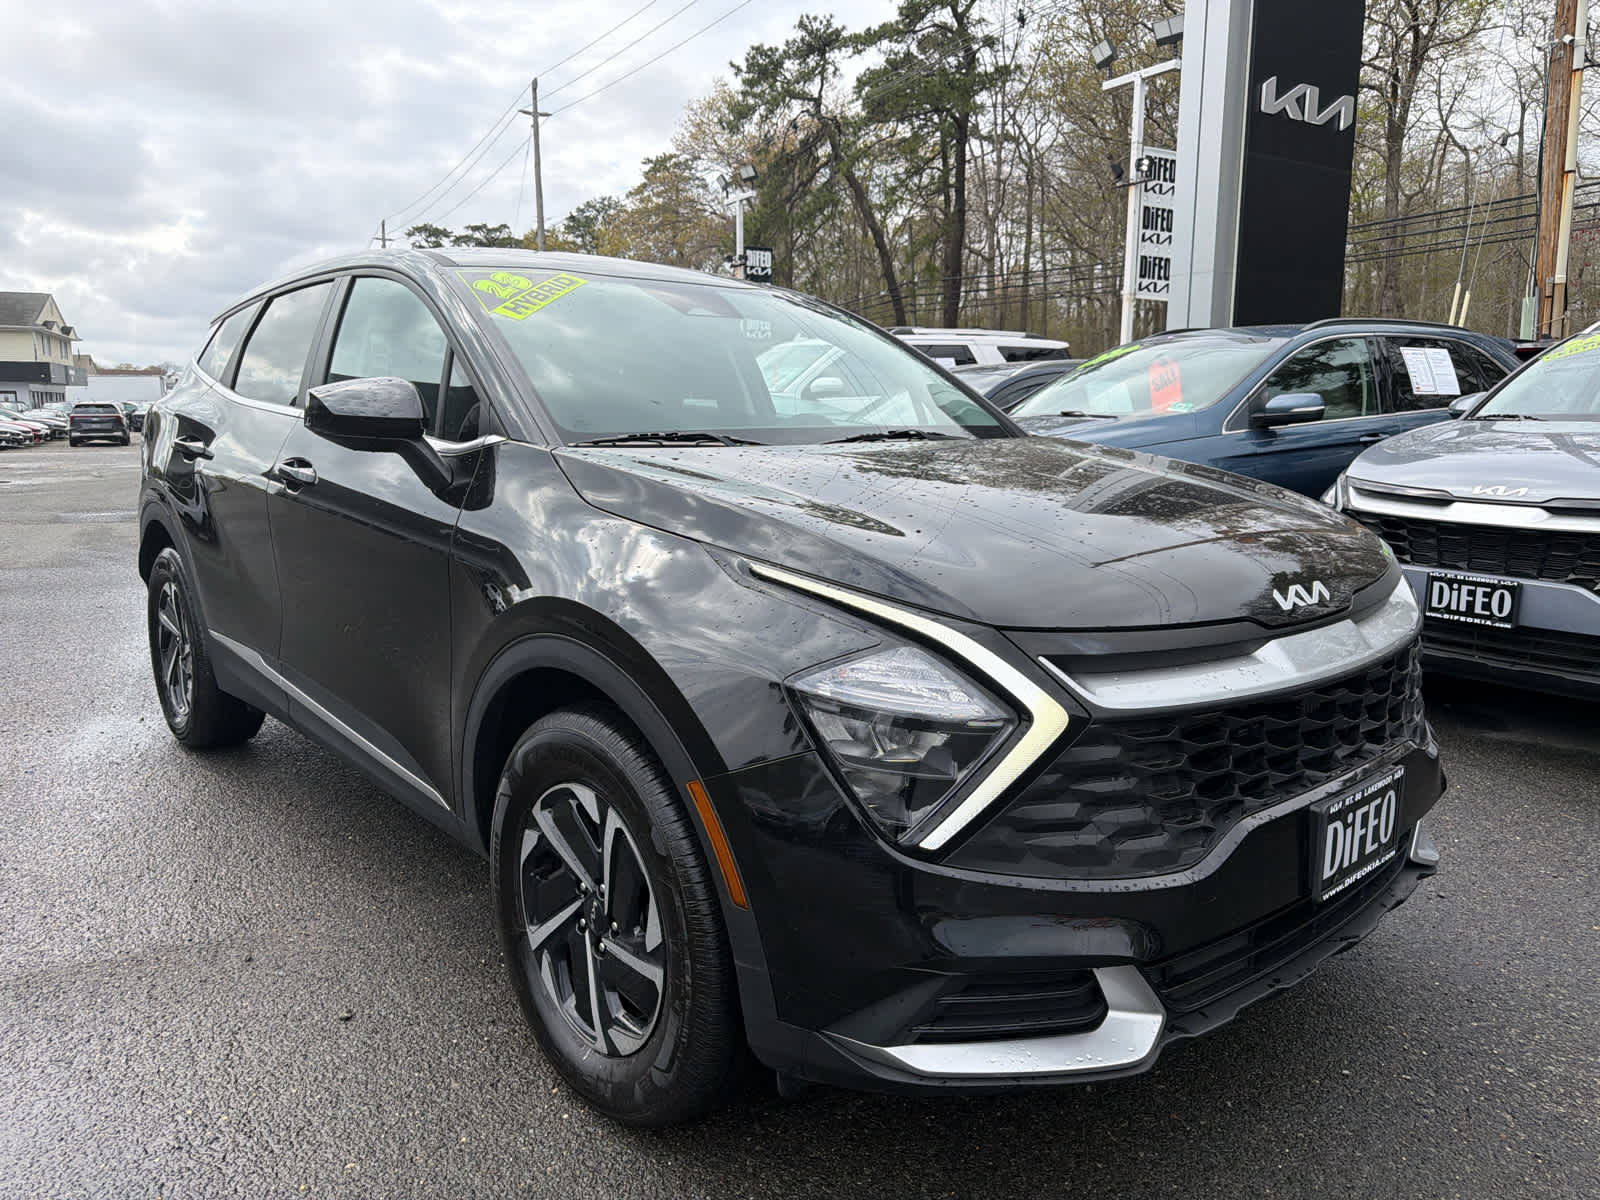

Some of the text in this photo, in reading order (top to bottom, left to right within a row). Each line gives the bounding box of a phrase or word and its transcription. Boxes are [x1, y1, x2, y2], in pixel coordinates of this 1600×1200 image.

[1260, 75, 1355, 132] KIA
[1143, 181, 1175, 196] KIA
[1142, 205, 1174, 233] DiFEO
[1141, 231, 1172, 245] KIA
[1139, 254, 1171, 281] DiFEO
[502, 275, 577, 316] HYBRID
[1138, 281, 1170, 294] KIA
[1472, 485, 1529, 497] KIA
[1272, 580, 1330, 610] KIA
[1431, 581, 1512, 618] DiFEO
[1322, 789, 1396, 881] DiFEO
[1322, 849, 1396, 901] www.DIFEOKIA.com
